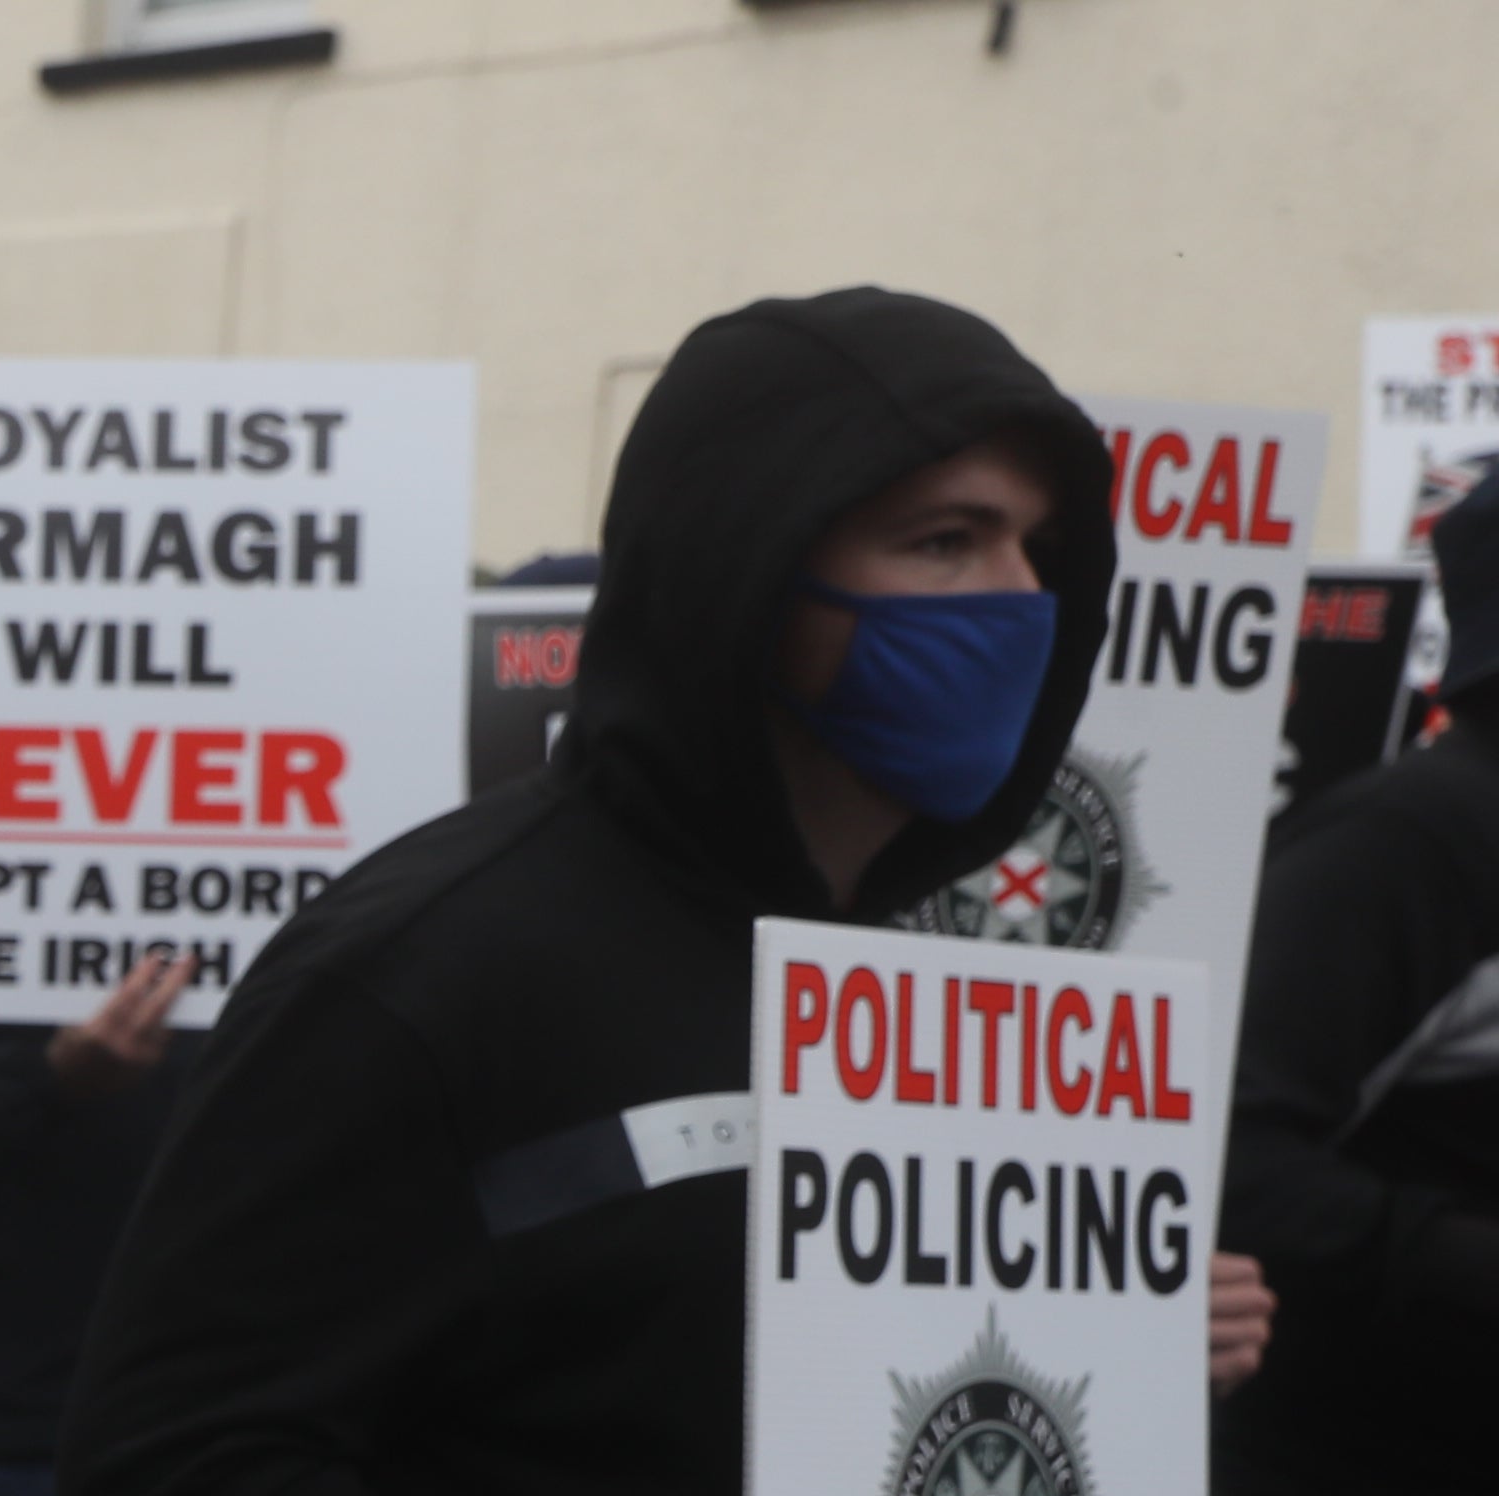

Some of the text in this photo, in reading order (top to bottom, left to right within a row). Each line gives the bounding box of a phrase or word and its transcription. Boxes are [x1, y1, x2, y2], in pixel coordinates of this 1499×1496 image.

[1109, 428, 1294, 548] ICAL
[6, 622, 234, 687] WILL
[495, 625, 584, 687] NO
[1107, 577, 1277, 690] ING
[72, 865, 115, 914] A
[139, 865, 336, 915] BORD
[780, 960, 1192, 1123] POLITICAL
[778, 1147, 1191, 1297] POLICING
